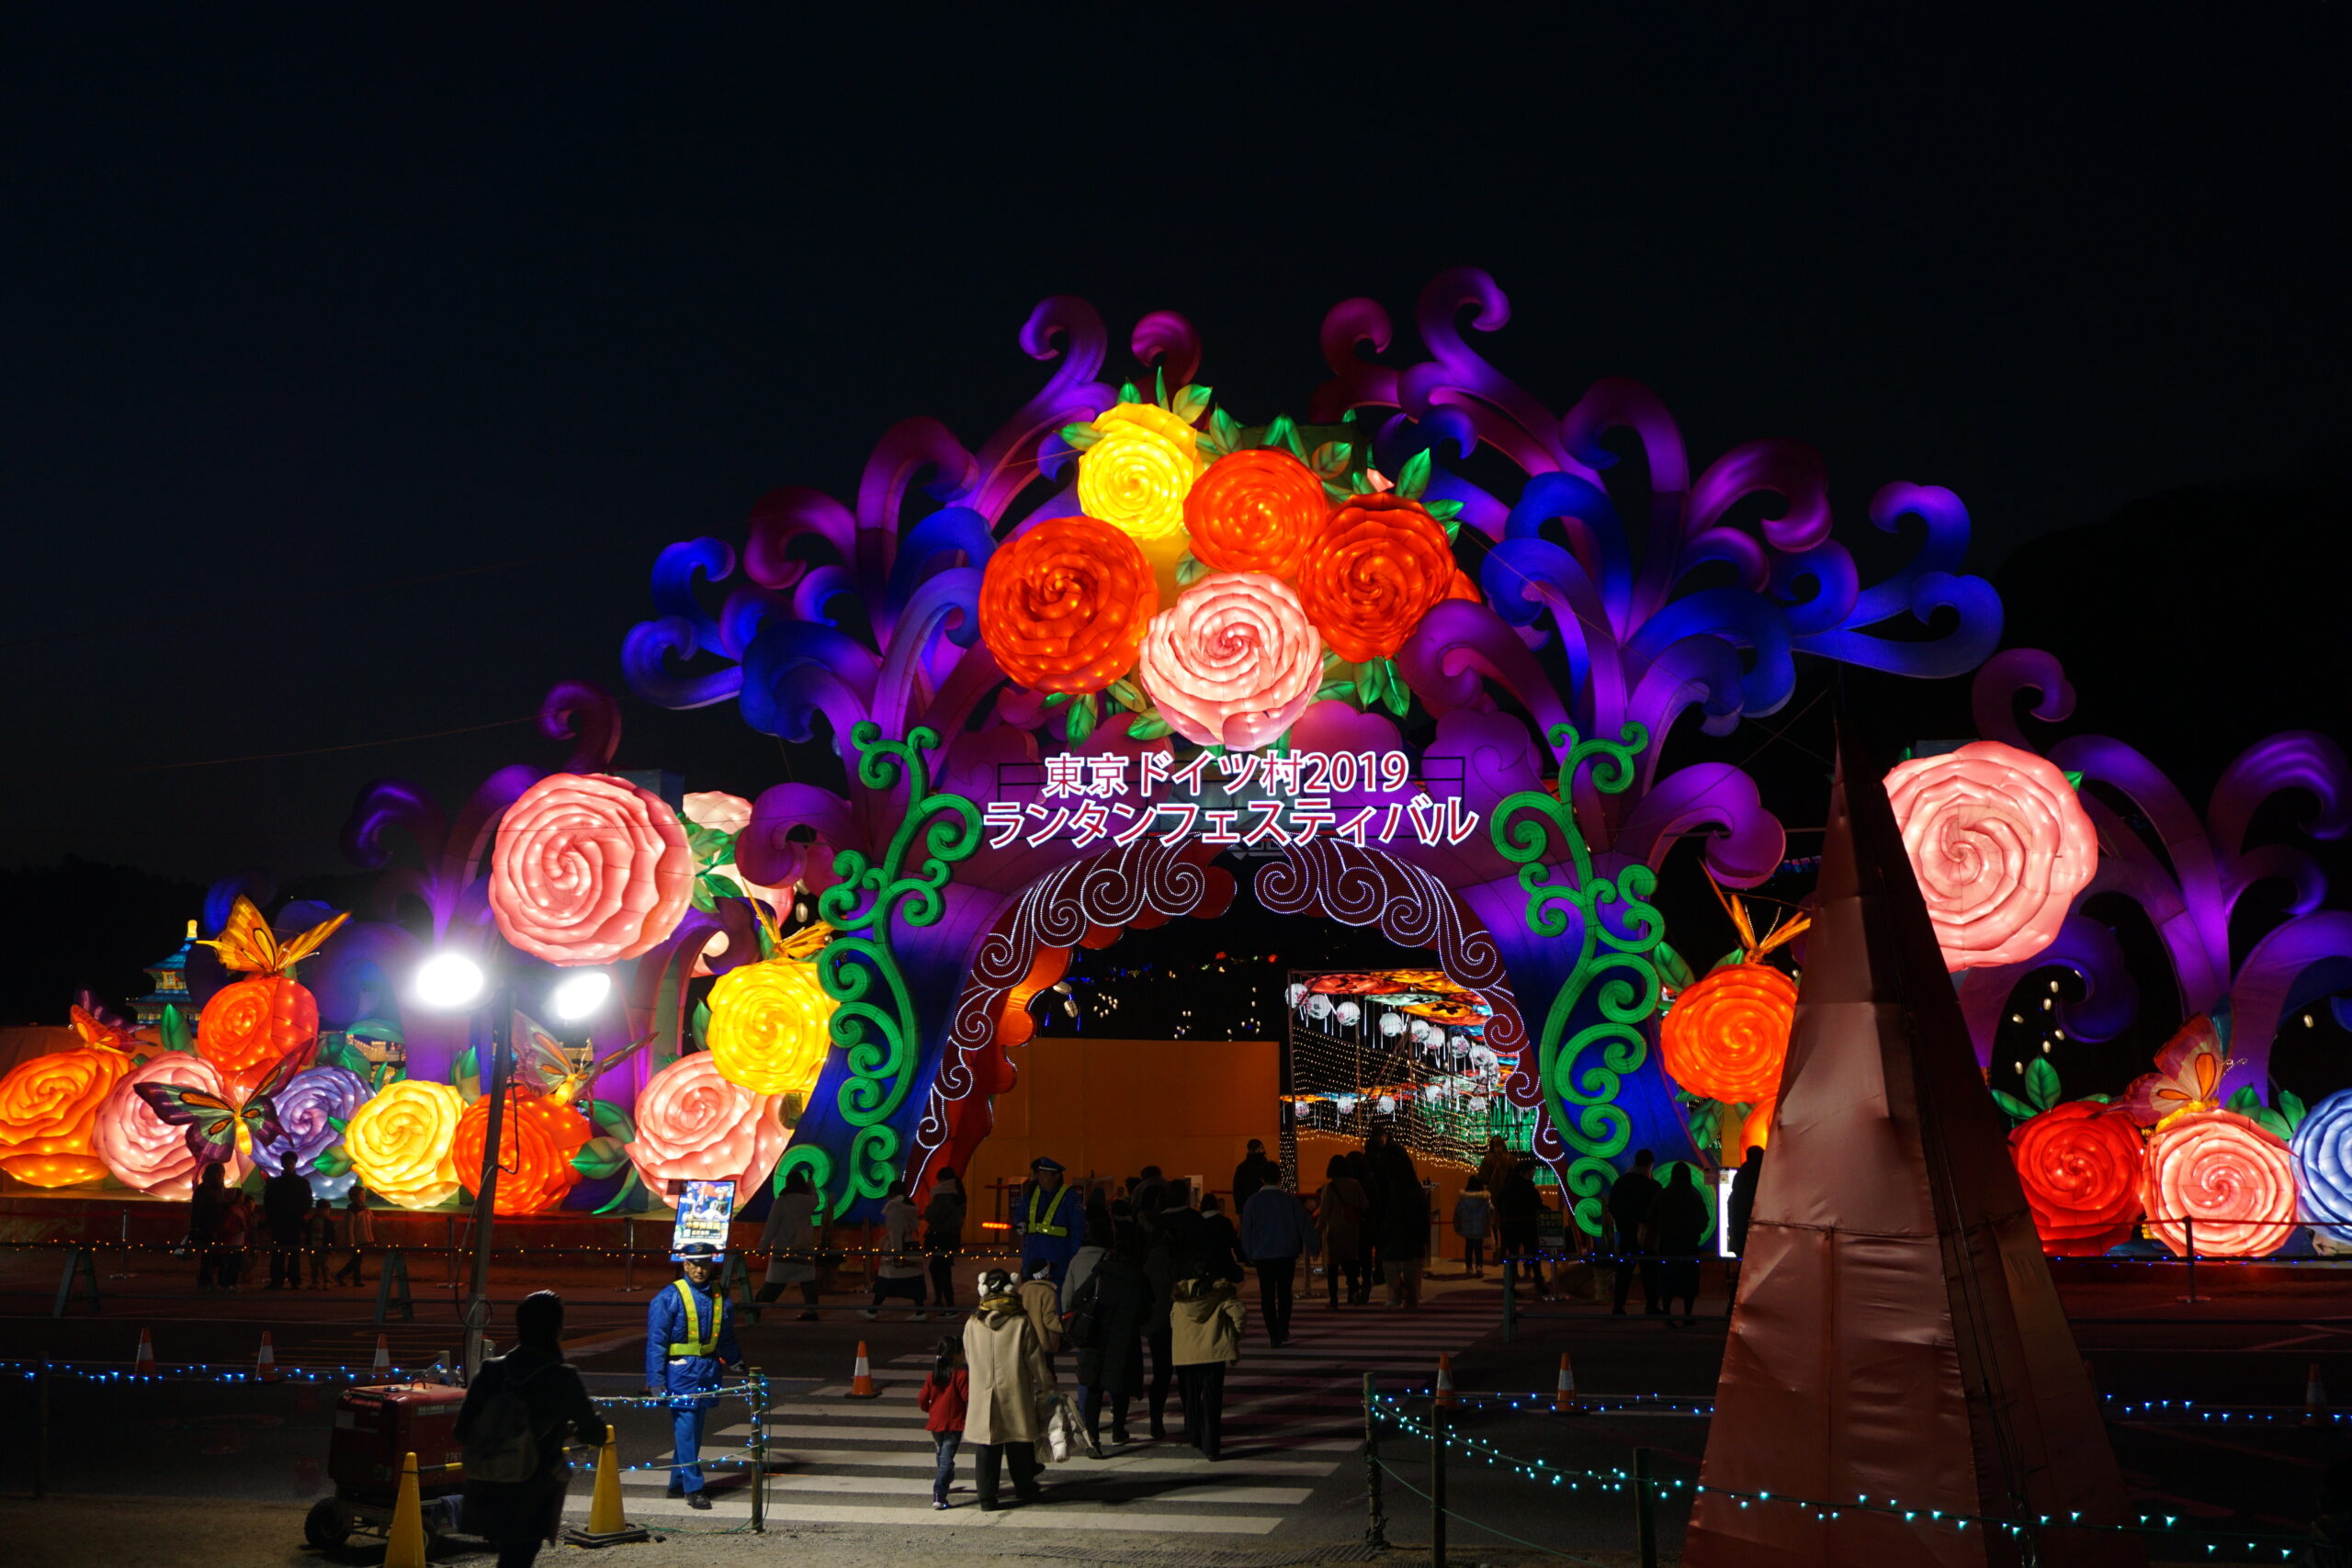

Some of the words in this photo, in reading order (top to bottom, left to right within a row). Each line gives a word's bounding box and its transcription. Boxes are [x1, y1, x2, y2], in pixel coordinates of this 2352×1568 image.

[1042, 750, 1409, 798] 東京ドイツ村2019
[982, 794, 1480, 848] ランタンフェスティバル
